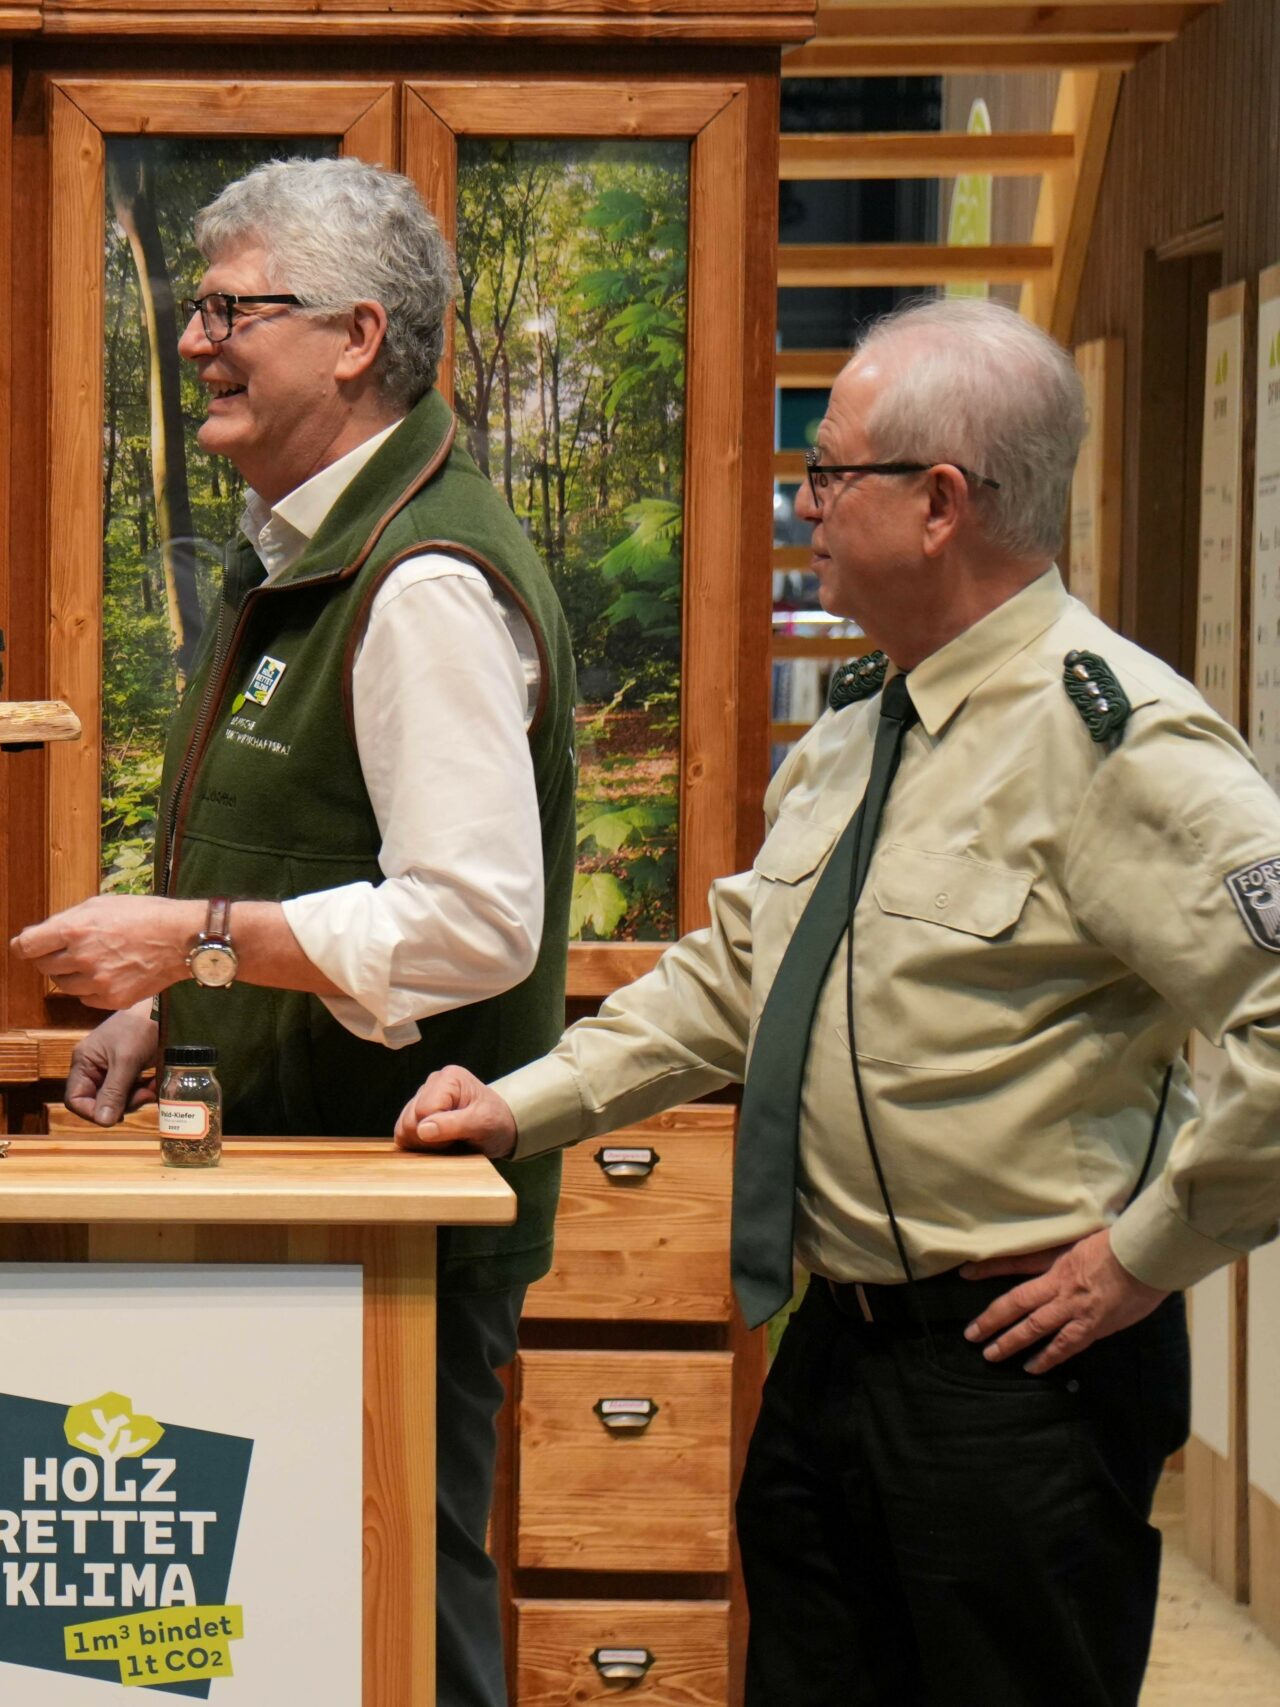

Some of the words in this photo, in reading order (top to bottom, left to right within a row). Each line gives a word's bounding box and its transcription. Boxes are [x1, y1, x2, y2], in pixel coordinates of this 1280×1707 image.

[24, 1457, 177, 1502] HOLZ
[3, 1562, 197, 1607] KLIMA
[138, 1615, 233, 1645] bindet
